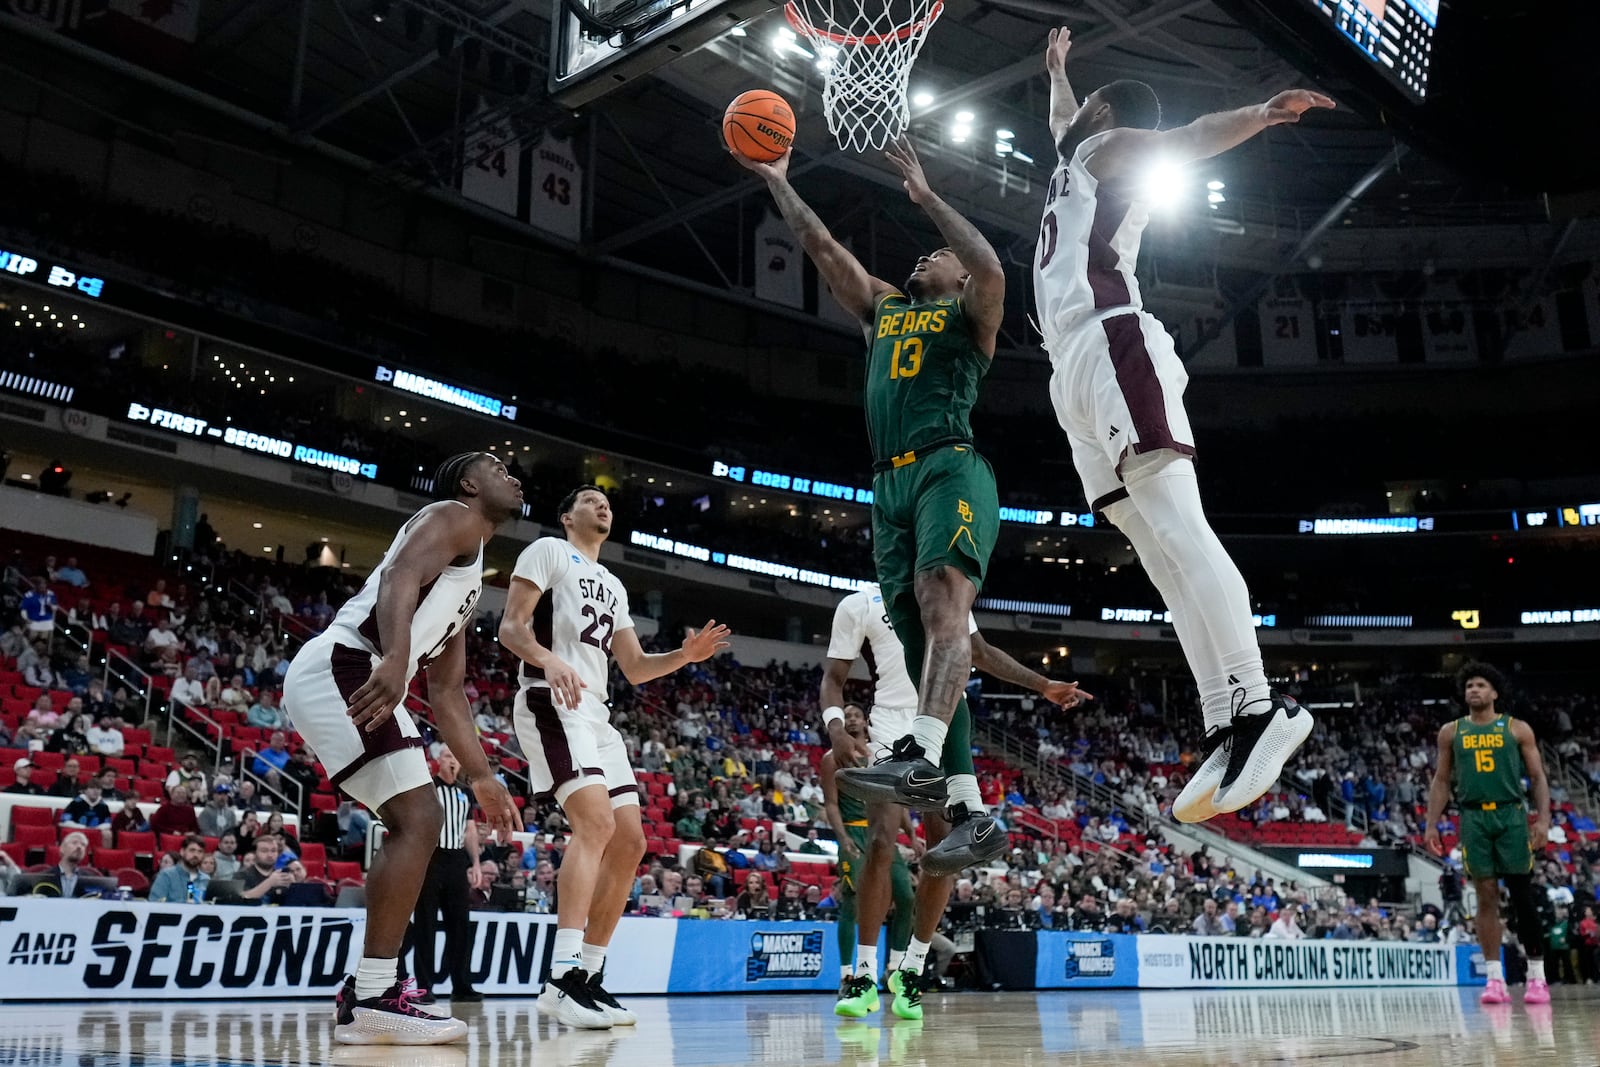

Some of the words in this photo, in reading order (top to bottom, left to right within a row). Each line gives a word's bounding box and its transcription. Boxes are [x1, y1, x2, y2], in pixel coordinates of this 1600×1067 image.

[543, 173, 570, 205] 43
[877, 309, 948, 338] BEARS
[890, 337, 923, 380] 13
[150, 408, 207, 436] FIRST
[224, 427, 292, 457] SECOND
[294, 445, 360, 475] ROUNDS
[752, 470, 791, 490] 2025
[812, 481, 854, 500] MEN'S
[631, 530, 674, 553] BAYLOR
[674, 541, 710, 562] BEARS
[727, 554, 798, 580] MISSISSIPPI
[799, 569, 830, 587] STATE
[579, 578, 619, 616] STATE
[580, 603, 615, 657] 22
[1462, 733, 1505, 749] BEARS
[1475, 749, 1495, 773] 15
[8, 932, 78, 965] AND
[82, 910, 355, 989] SECOND
[763, 934, 804, 953] MARCH
[767, 953, 822, 971] MADNESS
[1144, 953, 1172, 967] HOSTED
[1174, 953, 1185, 967] BY
[1189, 942, 1248, 981] NORTH
[1254, 945, 1329, 980] CAROLINA
[1333, 947, 1374, 980] STATE
[1377, 947, 1451, 981] UNIVERSITY
